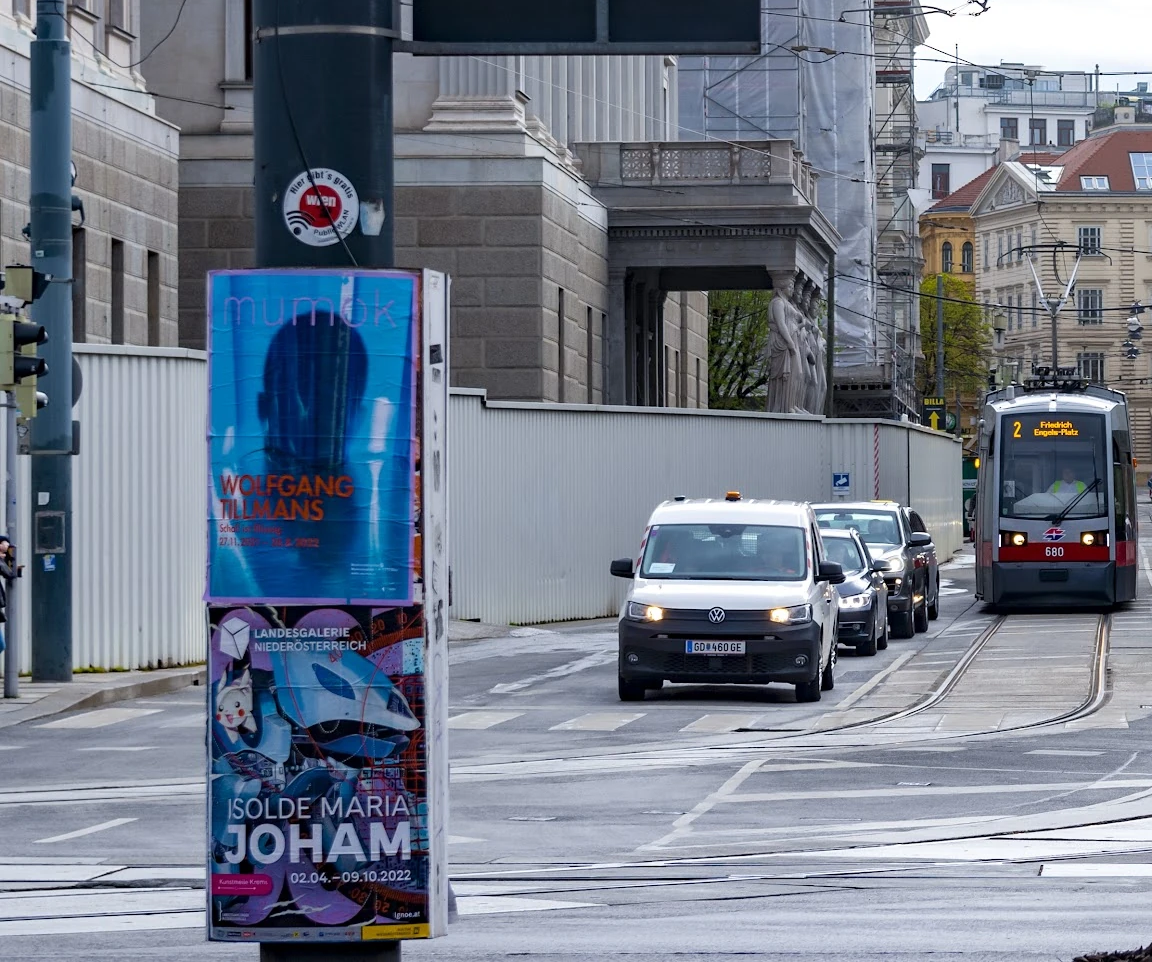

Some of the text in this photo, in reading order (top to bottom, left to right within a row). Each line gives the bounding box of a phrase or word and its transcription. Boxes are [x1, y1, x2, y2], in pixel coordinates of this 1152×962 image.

[289, 178, 306, 194] Hier
[333, 177, 354, 199] gratis
[223, 289, 397, 328] mumok
[1013, 421, 1022, 438] 2
[220, 474, 354, 498] WOLFGANG
[219, 498, 324, 521] TILLMANS
[1045, 547, 1064, 557] 680
[254, 627, 350, 639] LANDESGALERIE
[254, 639, 367, 652] NIEDERÖSTERREICH
[228, 795, 411, 820] ISOLDE MARIA
[224, 821, 411, 865] JOHAM
